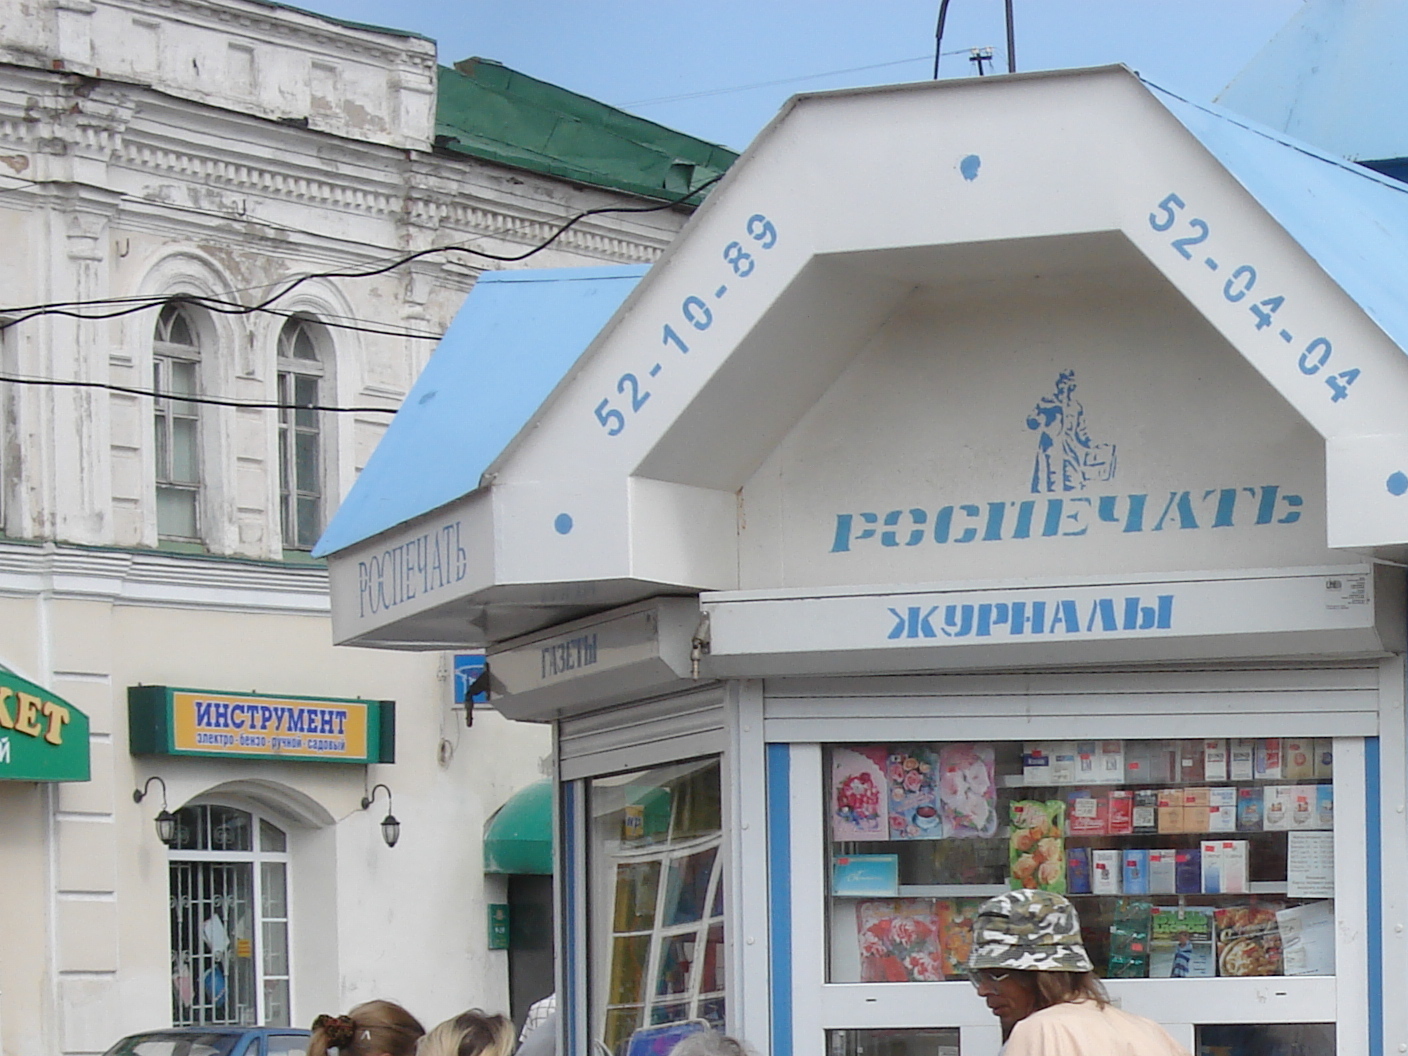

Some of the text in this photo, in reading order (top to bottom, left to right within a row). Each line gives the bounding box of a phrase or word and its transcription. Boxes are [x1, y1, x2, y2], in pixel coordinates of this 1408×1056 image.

[594, 213, 777, 436] 52-10-89
[1149, 192, 1361, 403] 52-04-04
[829, 485, 1303, 553] РОСПЕЧАТЬ
[358, 521, 467, 618] РОСПЕЧАТЬ
[886, 594, 1174, 640] ЖУРНАЛЫ
[541, 634, 598, 679] ГАЗЕТЫ
[195, 702, 347, 734] ИНСТРУМЕНТ
[198, 732, 345, 751] электро бензо ручной садовый
